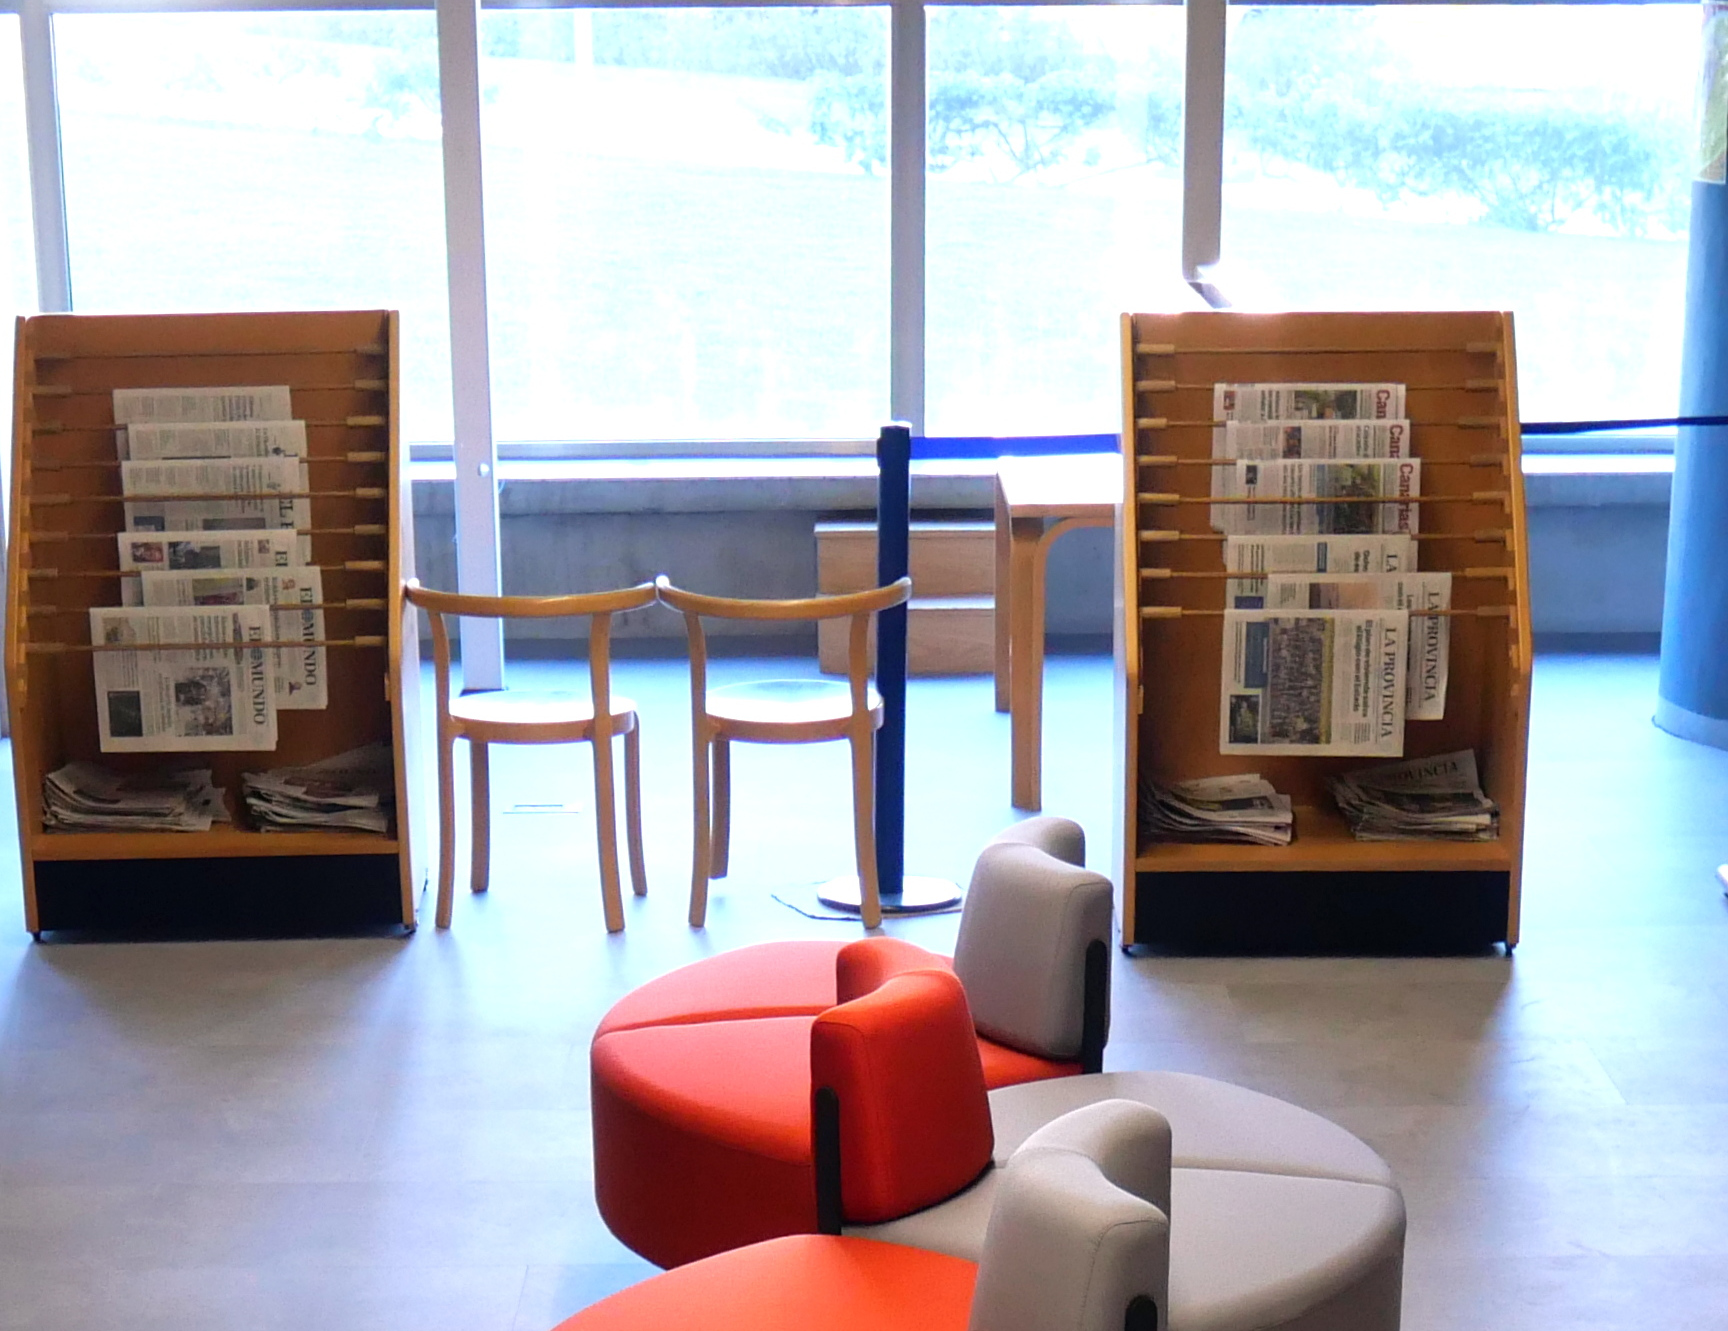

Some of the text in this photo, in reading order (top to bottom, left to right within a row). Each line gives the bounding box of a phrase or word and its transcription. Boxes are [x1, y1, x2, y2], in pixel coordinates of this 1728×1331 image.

[302, 623, 317, 686] MUNDO
[1364, 628, 1373, 646] plan
[1364, 647, 1372, 658] de
[1424, 615, 1440, 702] PROVINCIA
[251, 661, 266, 726] MUNDO
[1352, 683, 1360, 712] Estado
[1362, 659, 1371, 694] vivienda
[1381, 627, 1397, 738] LA PROVINCIA
